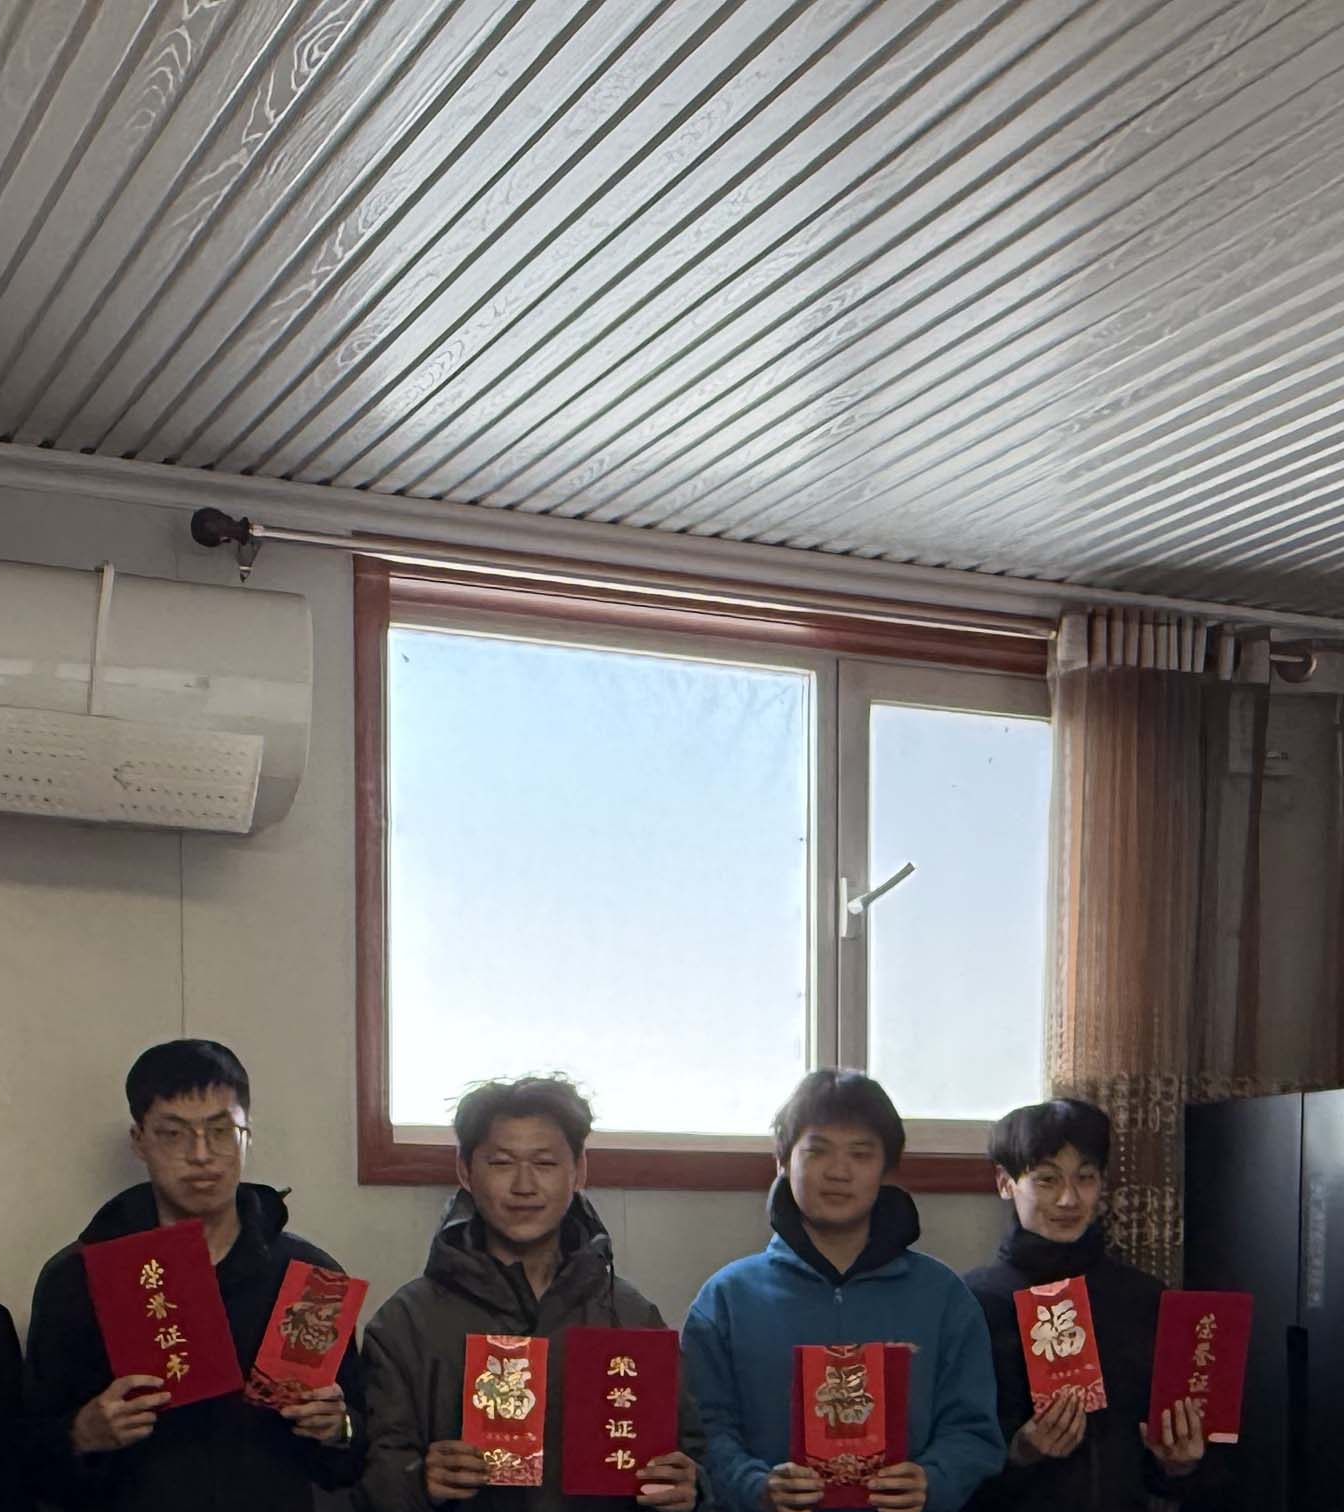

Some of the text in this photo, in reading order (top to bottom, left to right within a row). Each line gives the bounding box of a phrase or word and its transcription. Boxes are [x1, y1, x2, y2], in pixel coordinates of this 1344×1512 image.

[139, 1258, 191, 1383] 荣誉证书
[1030, 1299, 1087, 1362] 福
[472, 1354, 537, 1421] 福
[605, 1355, 638, 1470] 荣誉证书
[814, 1364, 875, 1428] 福
